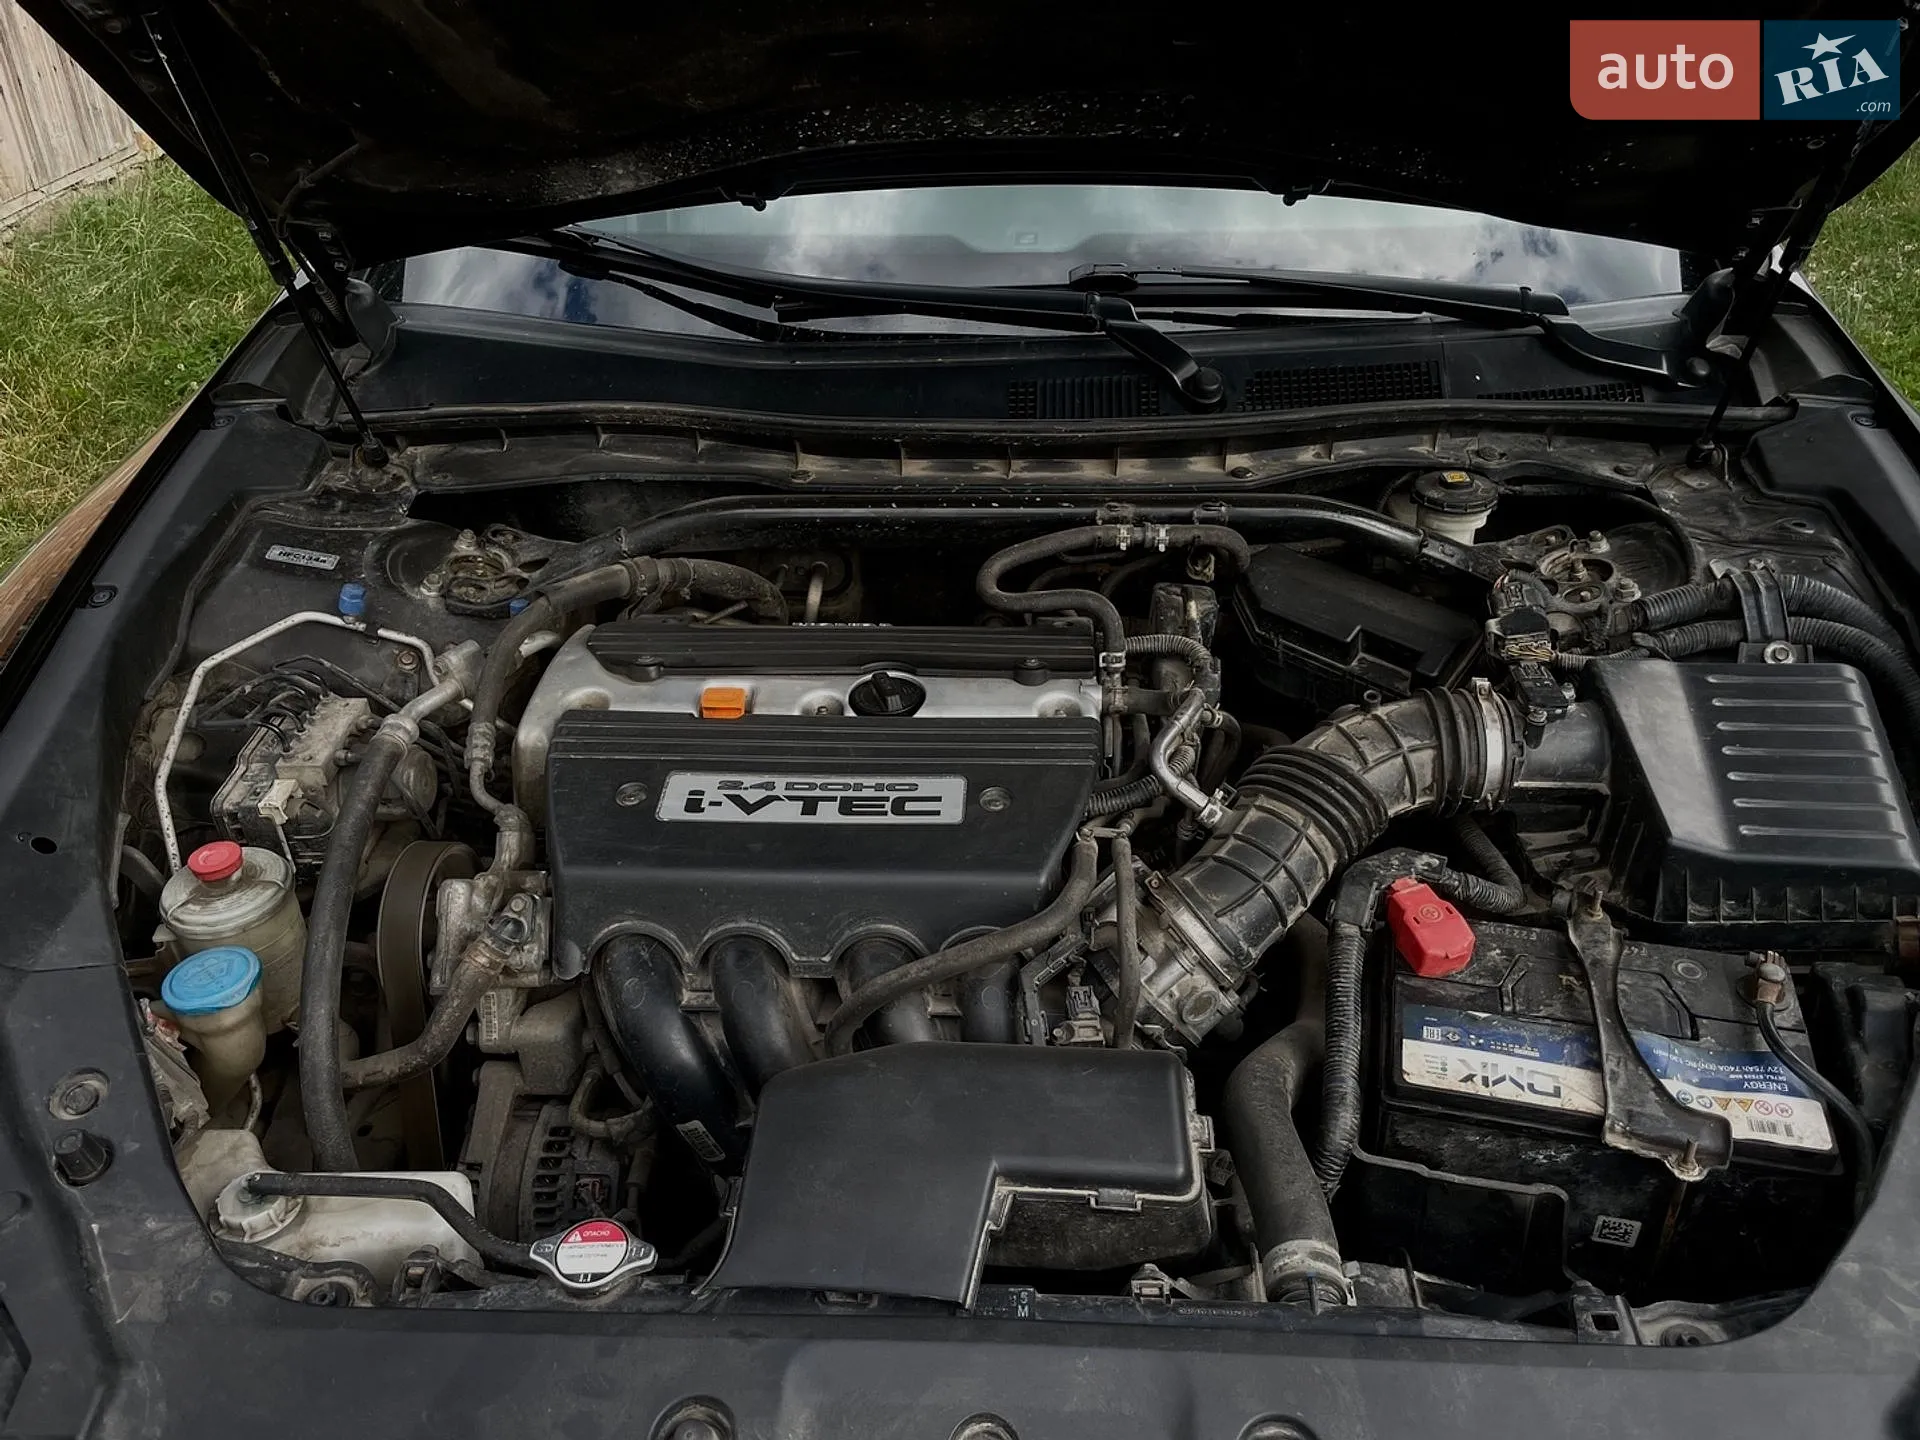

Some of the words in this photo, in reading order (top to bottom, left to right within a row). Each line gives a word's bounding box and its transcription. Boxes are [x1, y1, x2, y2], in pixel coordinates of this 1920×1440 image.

[717, 780, 776, 792] 2.4
[684, 789, 942, 816] i-VTEC
[1744, 1082, 1788, 1092] ENERGY
